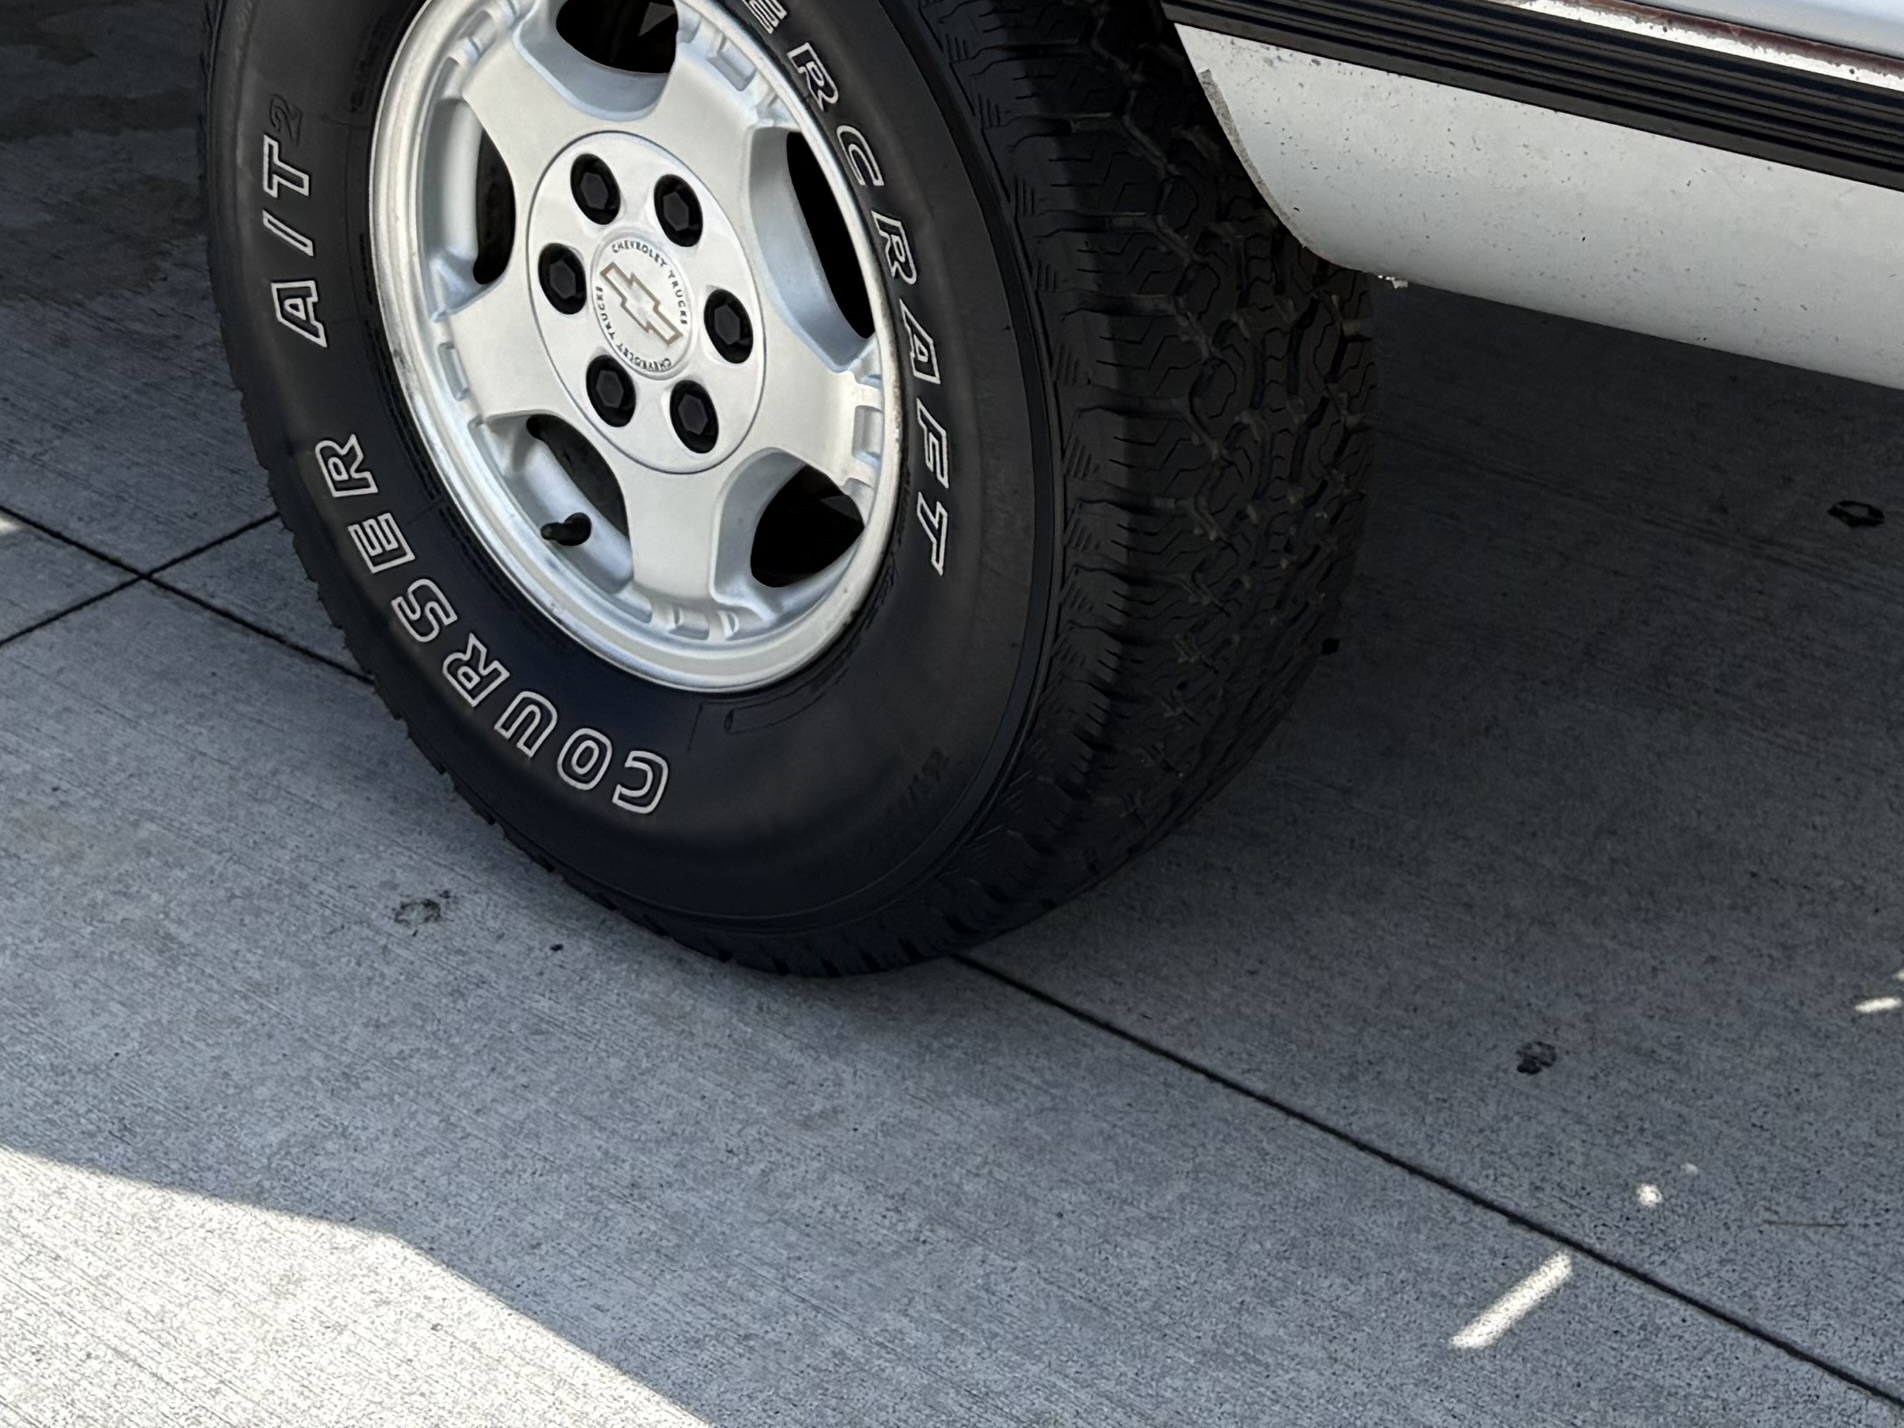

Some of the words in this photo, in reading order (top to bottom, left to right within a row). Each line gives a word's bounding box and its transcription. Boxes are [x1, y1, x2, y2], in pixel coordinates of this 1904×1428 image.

[611, 239, 667, 267] CHEVROLET
[667, 269, 688, 325] TRUCKS
[316, 433, 669, 814] COURSER
